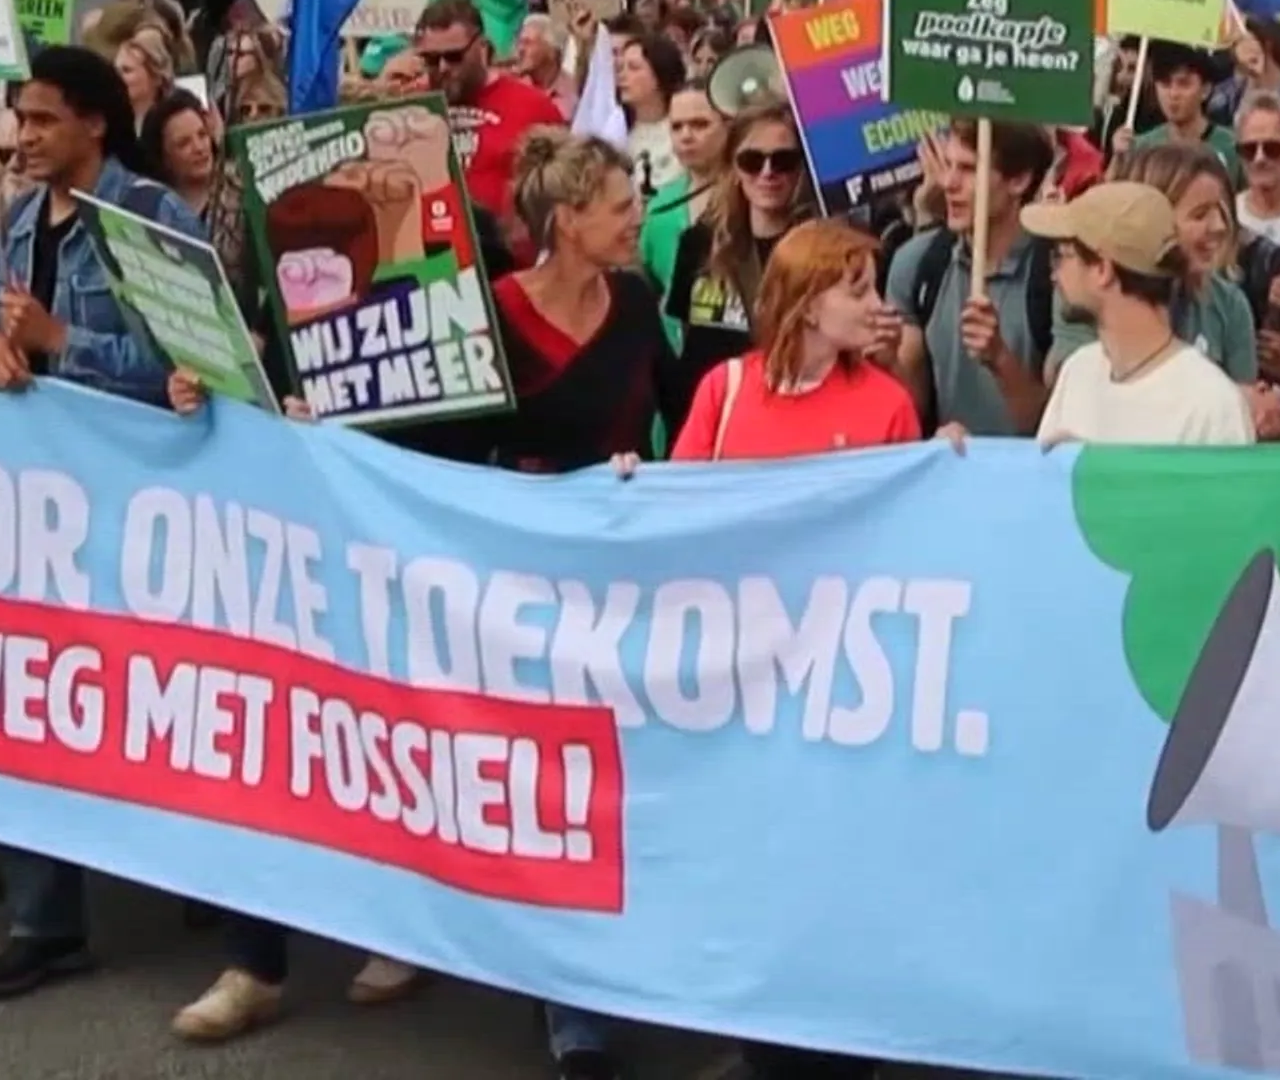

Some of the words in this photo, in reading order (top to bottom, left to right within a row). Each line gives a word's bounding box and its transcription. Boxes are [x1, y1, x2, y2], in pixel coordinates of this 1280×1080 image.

[805, 8, 861, 50] WEG
[902, 39, 952, 60] waar
[956, 44, 982, 66] ga
[984, 41, 1008, 69] je
[1012, 42, 1080, 71] heen?
[914, 10, 1067, 50] poolkapje
[840, 60, 885, 100] WE
[290, 316, 355, 371] WIJ
[356, 266, 489, 358] ZIJN
[302, 365, 374, 419] MET
[379, 334, 504, 406] MEER
[121, 486, 337, 665] ONZE
[346, 540, 991, 757] TOEKOMST.
[124, 654, 273, 788] MET
[287, 686, 593, 863] FOSSIEL!
